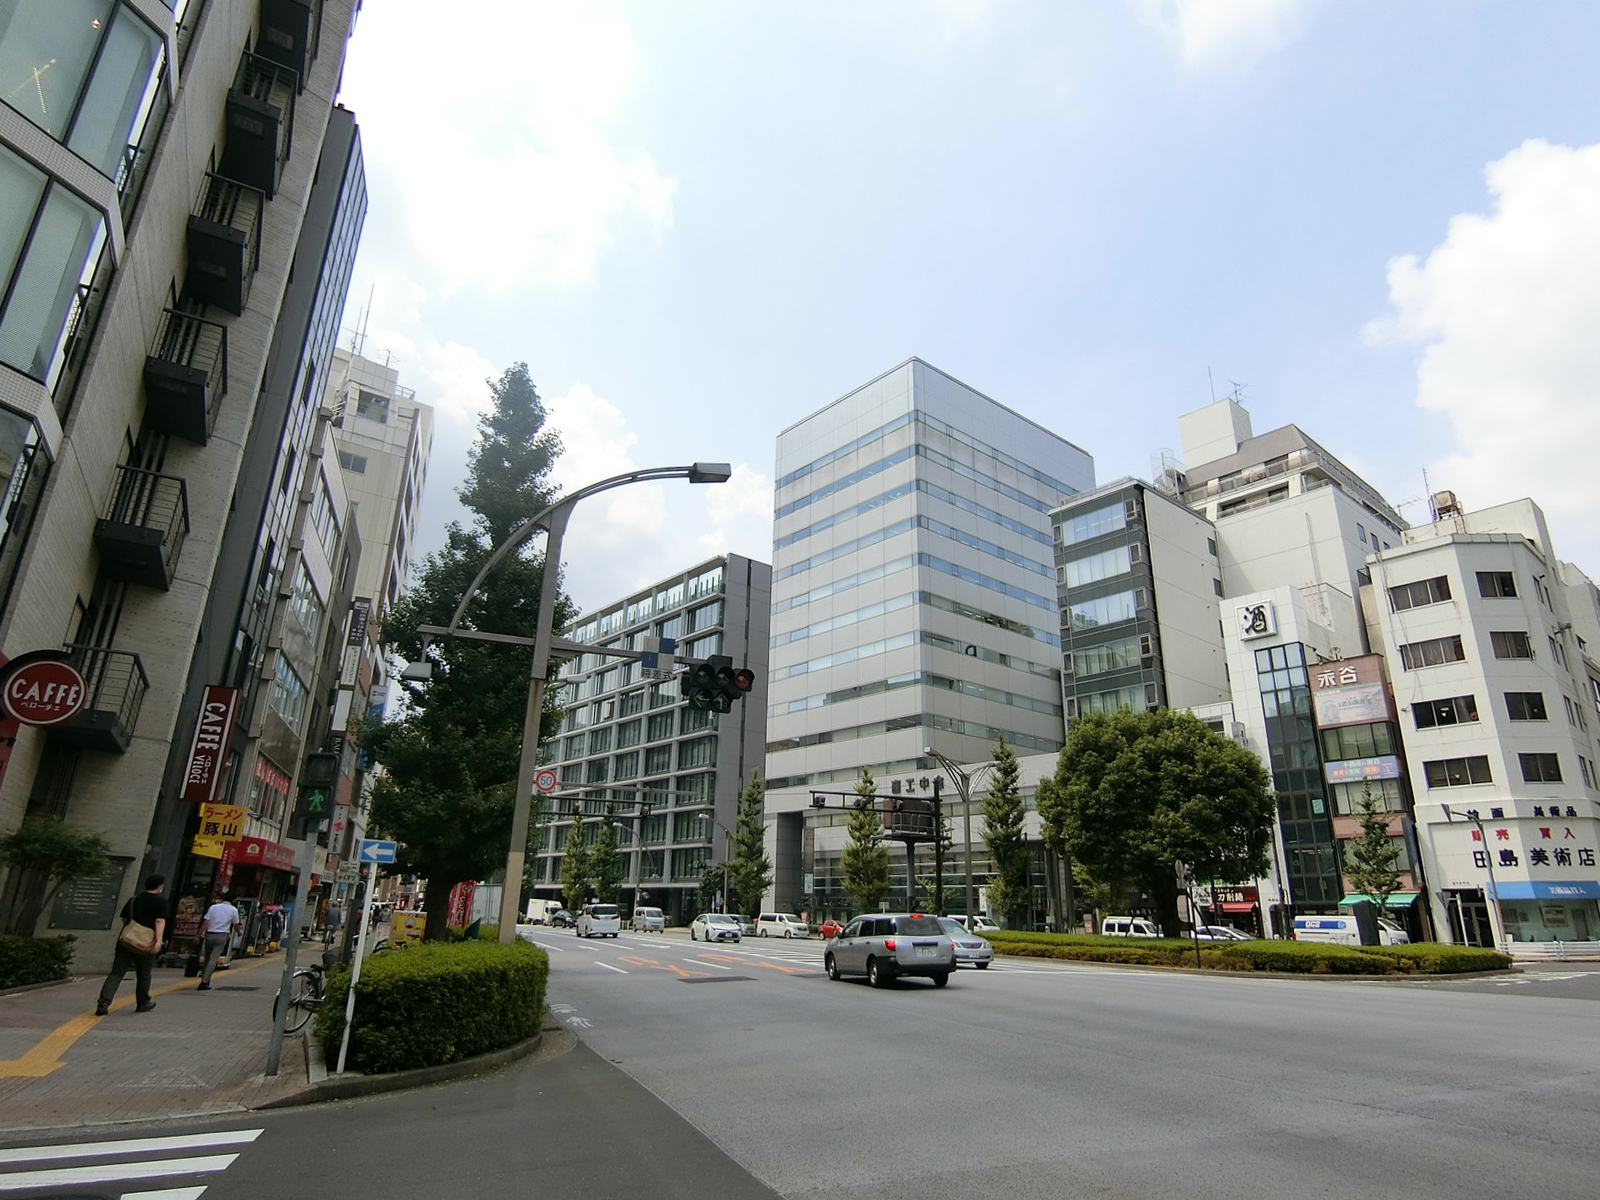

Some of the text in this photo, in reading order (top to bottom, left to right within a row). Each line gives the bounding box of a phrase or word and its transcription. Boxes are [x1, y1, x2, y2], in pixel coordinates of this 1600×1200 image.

[1243, 605, 1267, 634] 酒
[189, 755, 206, 784] VELOCE
[540, 775, 552, 786] 50
[205, 807, 243, 820] ラーメン
[1533, 805, 1577, 817] 美術品
[203, 822, 238, 837] 豚山
[1539, 827, 1576, 839] 買入
[1472, 847, 1596, 868] 田島美術店
[1217, 892, 1244, 902] 刀削麺
